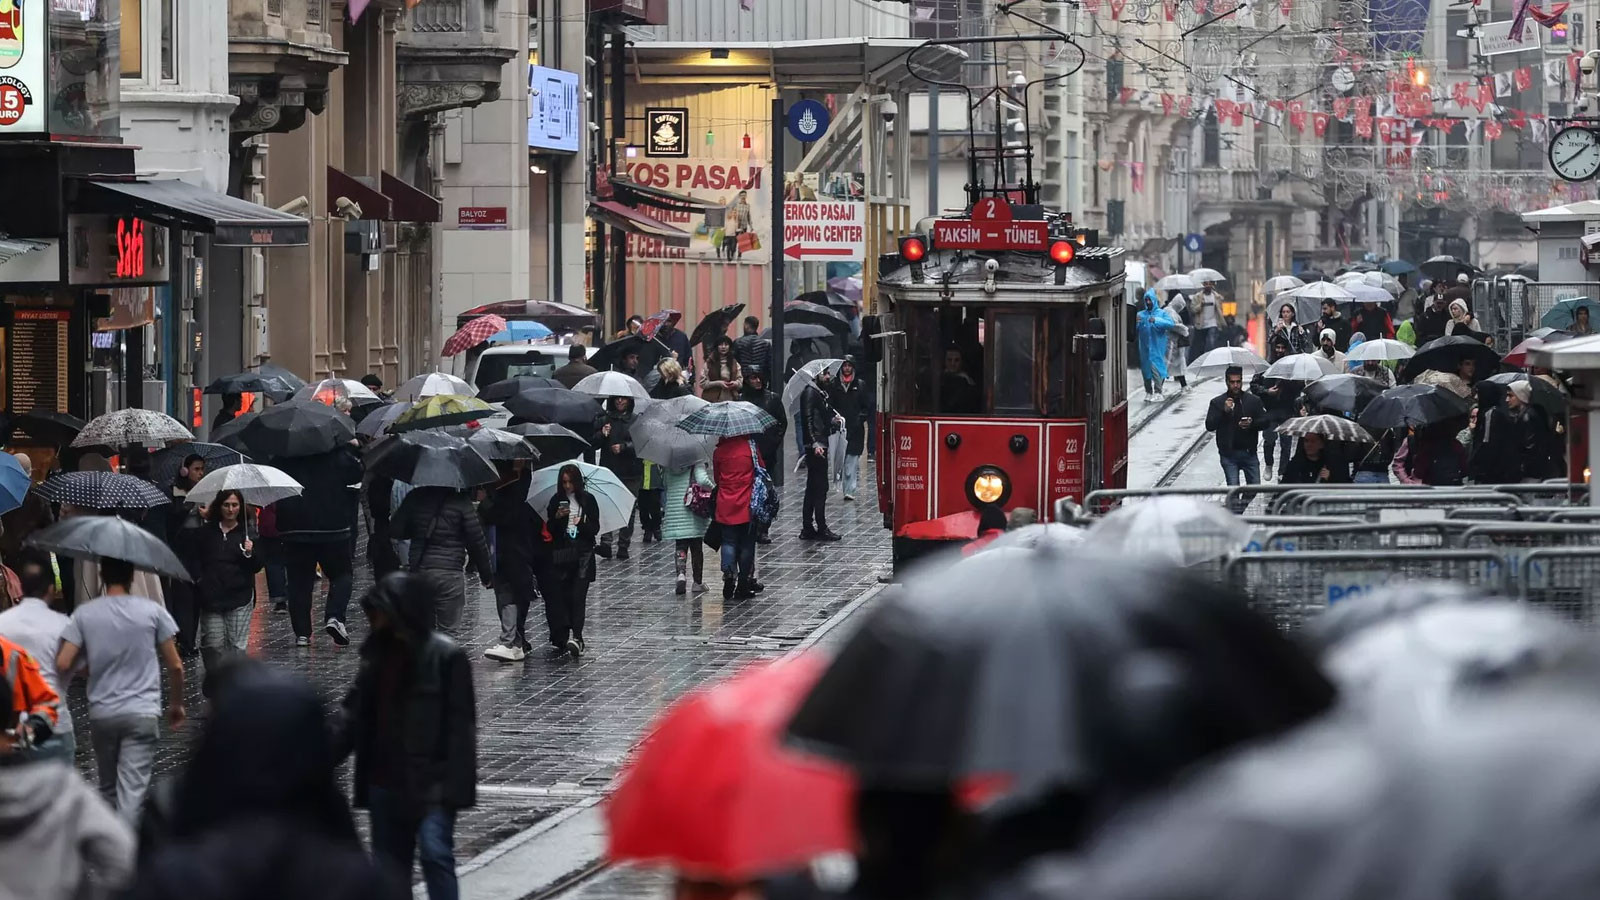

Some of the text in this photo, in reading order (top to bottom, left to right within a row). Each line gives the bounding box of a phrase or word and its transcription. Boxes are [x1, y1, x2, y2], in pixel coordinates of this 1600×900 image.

[0, 76, 31, 98] XOLOGY
[460, 210, 487, 218] BALYOZ
[820, 204, 855, 221] PASAJI
[986, 200, 996, 219] 2
[783, 225, 863, 243] OPPING CENTER
[939, 224, 981, 243] TAKSİM
[1004, 225, 1042, 244] TÜNEL
[900, 435, 912, 450] 223
[1065, 439, 1078, 454] 223
